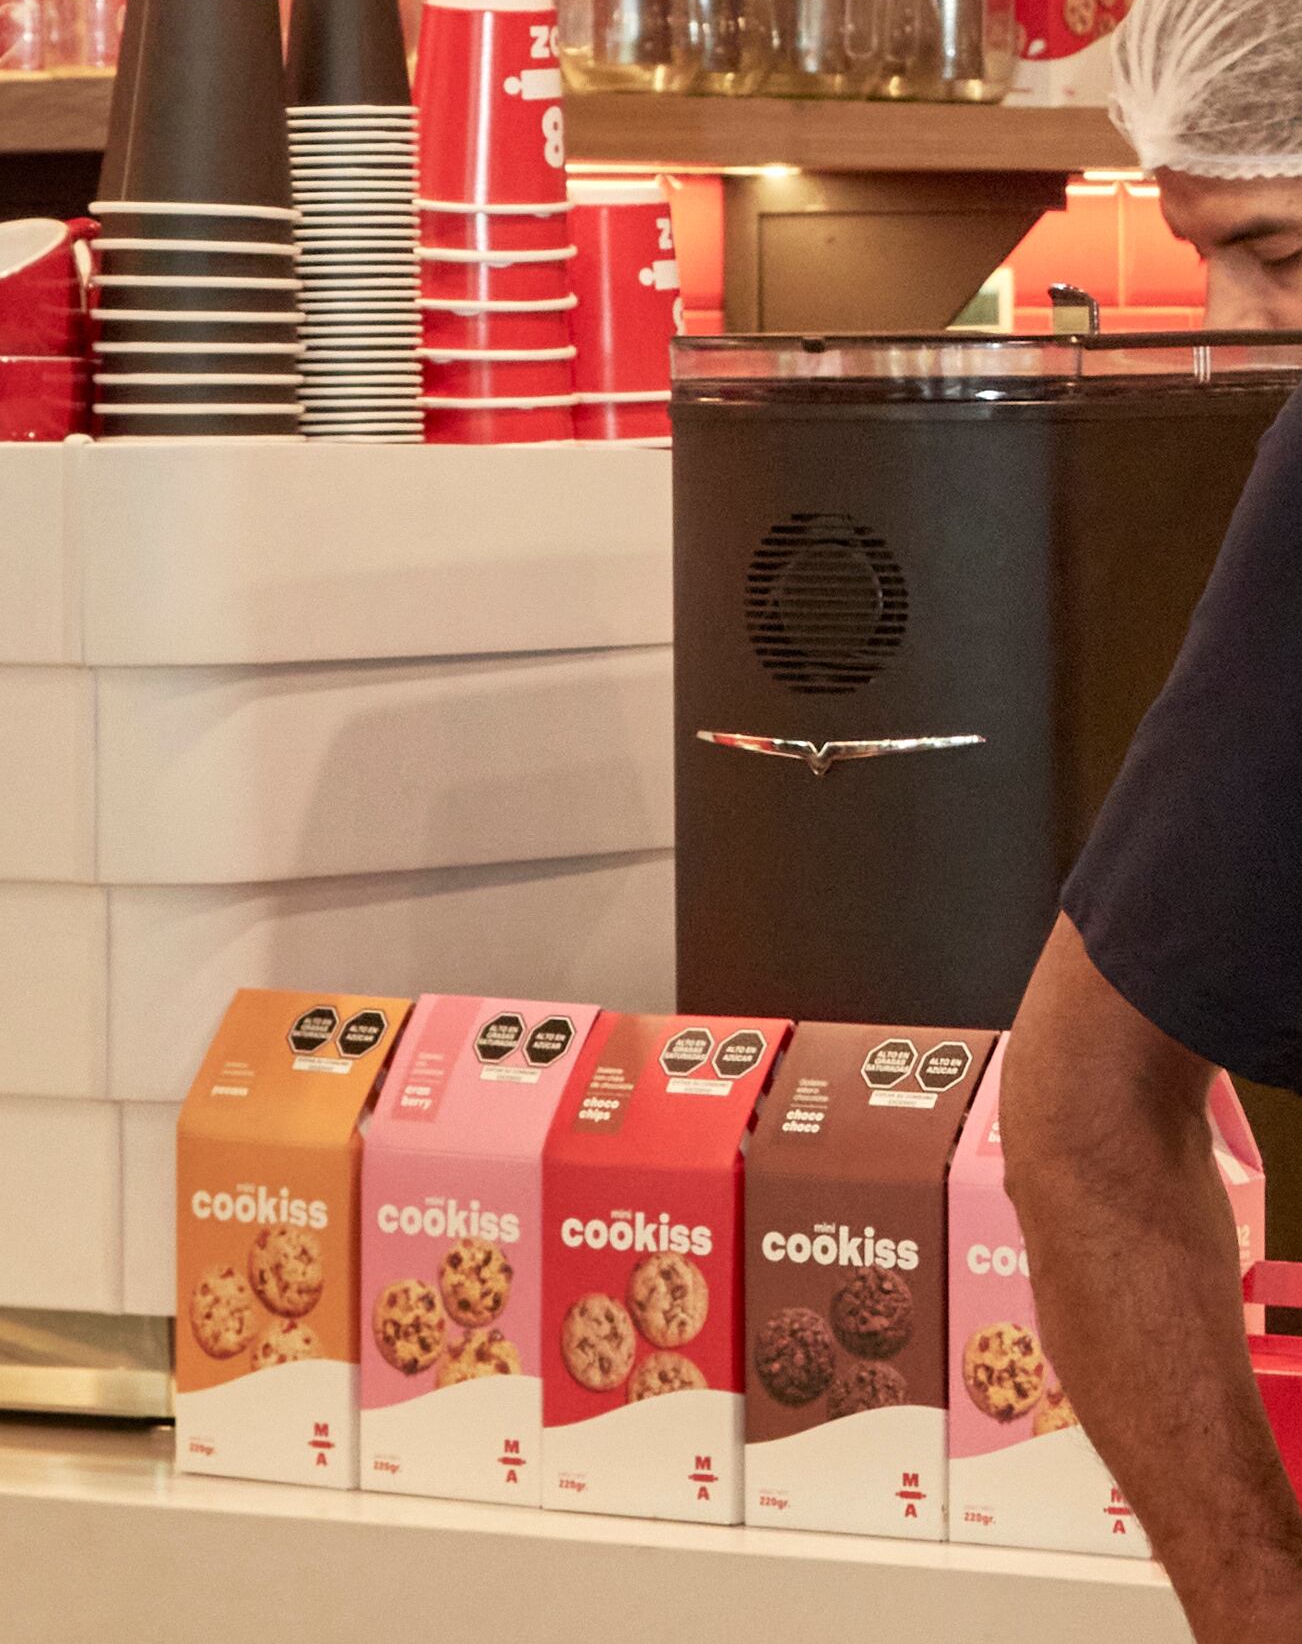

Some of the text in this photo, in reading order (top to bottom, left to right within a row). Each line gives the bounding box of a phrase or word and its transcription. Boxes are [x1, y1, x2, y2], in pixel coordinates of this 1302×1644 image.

[929, 1058, 962, 1067] ALTO EN
[583, 1097, 620, 1109] choco
[579, 1108, 611, 1123] chips
[786, 1109, 825, 1122] choco
[782, 1121, 821, 1134] choco
[192, 1185, 328, 1230] cookiss
[377, 1198, 520, 1242] cookiss
[561, 1212, 712, 1256] cookiss
[814, 1223, 837, 1234] mini
[762, 1226, 919, 1271] cookiss
[314, 1423, 329, 1437] M
[504, 1439, 520, 1453] M
[316, 1453, 328, 1466] A
[695, 1455, 712, 1470] M
[506, 1469, 518, 1483] A
[902, 1472, 919, 1487] M
[697, 1486, 710, 1501] A
[904, 1503, 917, 1518] A
[1113, 1519, 1126, 1535] A
